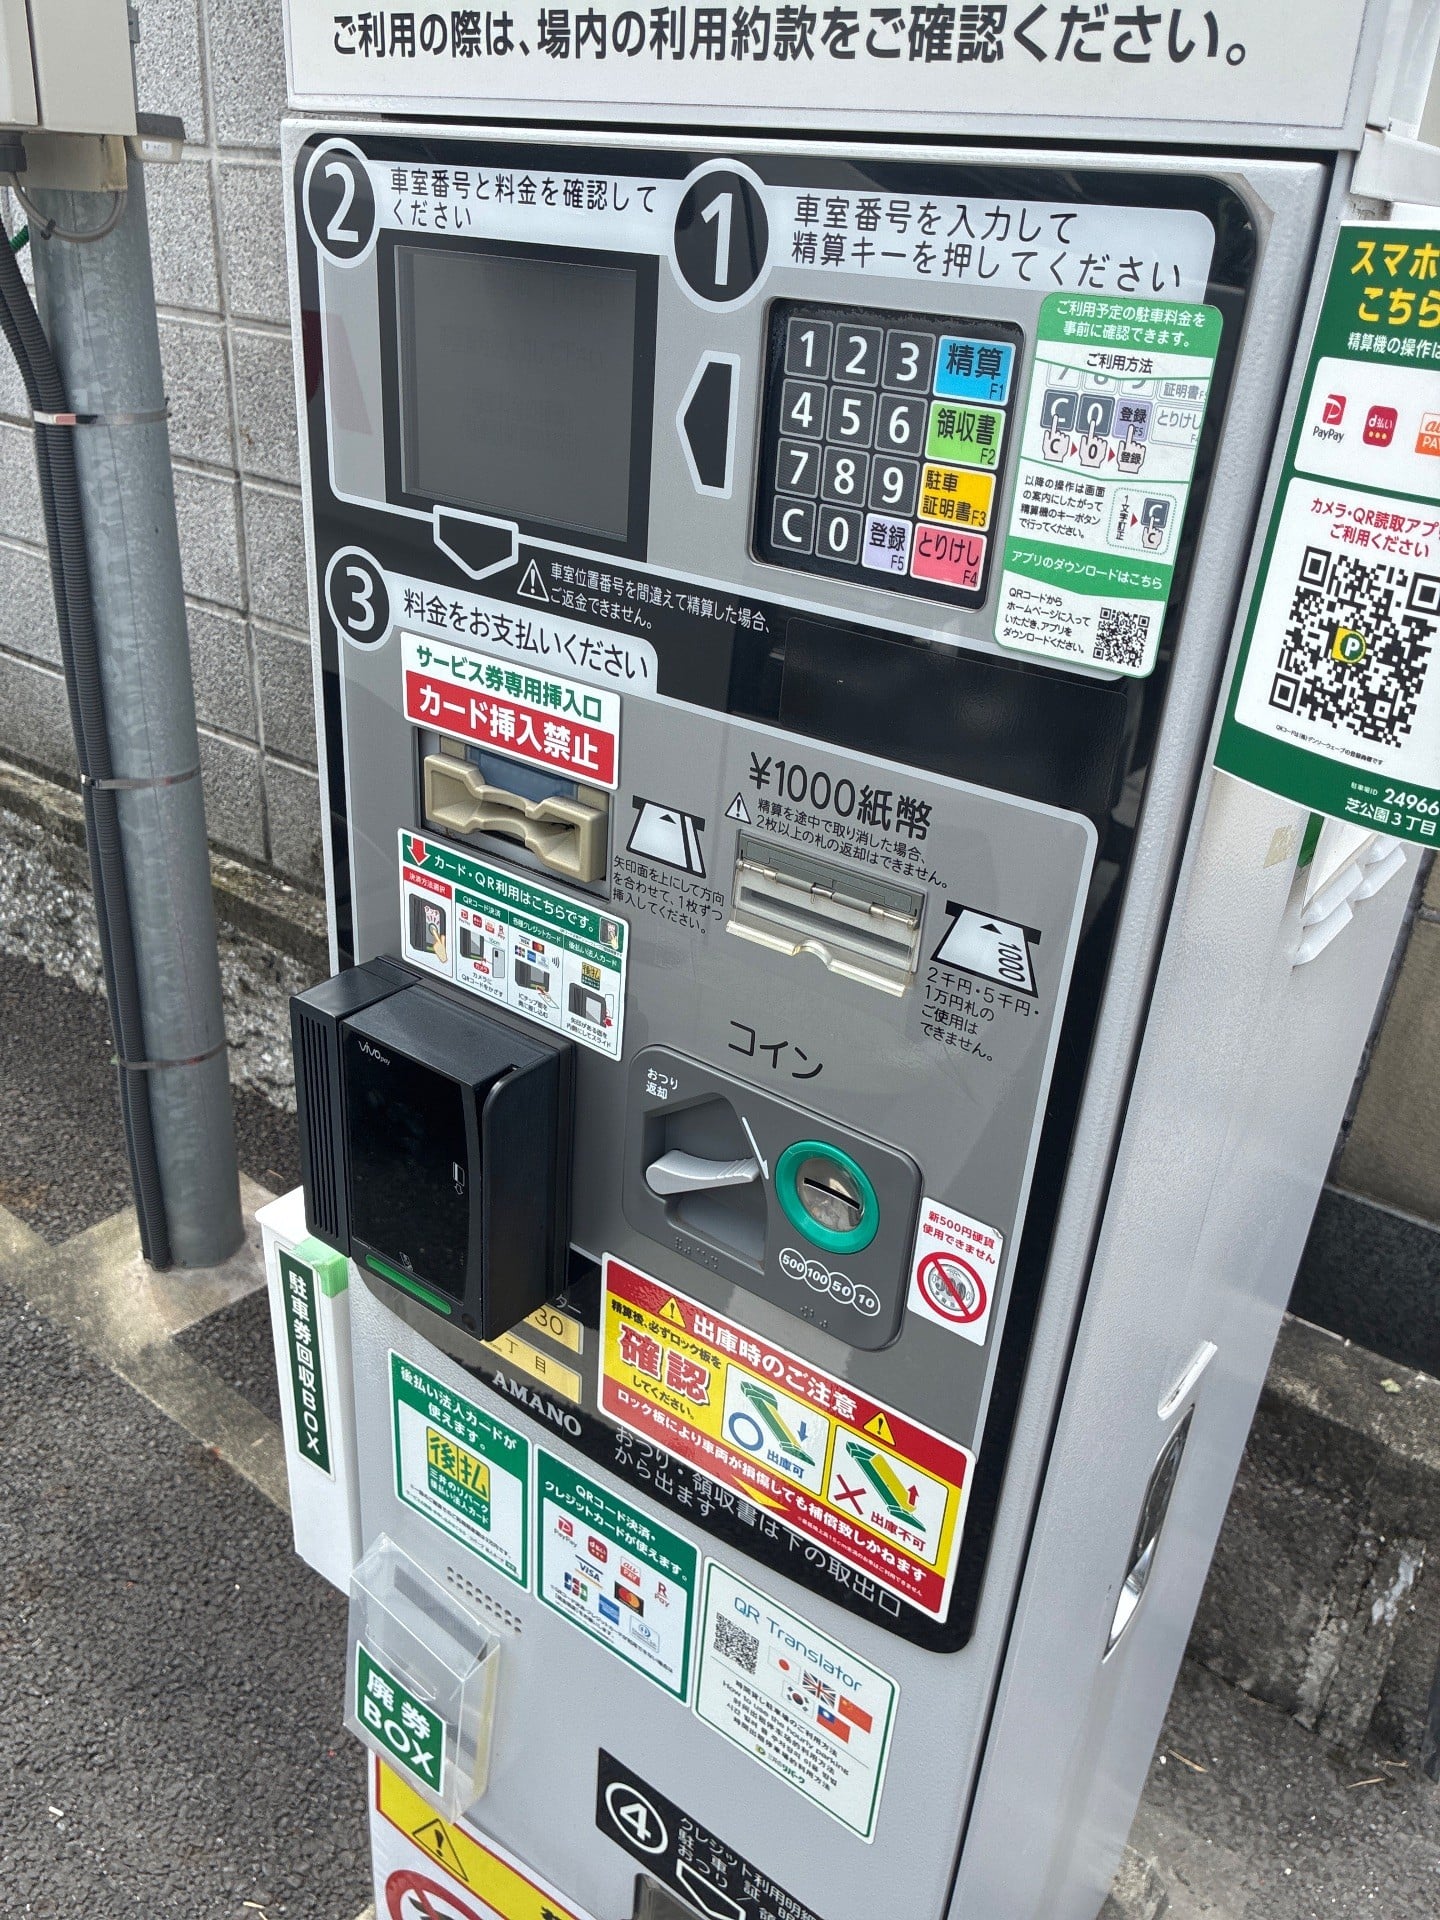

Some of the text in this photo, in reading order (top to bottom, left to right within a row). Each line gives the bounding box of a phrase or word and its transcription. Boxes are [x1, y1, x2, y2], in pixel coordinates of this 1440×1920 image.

[332, 4, 1246, 66] ご利用の際は、場内の利用約款をご確認ください。
[325, 162, 359, 243] 2
[390, 167, 657, 213] 車室番号と料金を確認して
[391, 201, 472, 229] ください
[794, 195, 1078, 245] 車室番号を入力して
[701, 192, 734, 286] 1
[792, 231, 1181, 293] 精算キーを押してください
[1351, 240, 1440, 281] スマホ
[1056, 299, 1206, 328] ご利用予定の駐車料金を
[1358, 287, 1440, 328] こちら
[800, 330, 814, 367] 1
[1063, 320, 1190, 349] 事前に確認できます。
[845, 336, 868, 375] 2
[896, 342, 920, 381] 3
[945, 343, 1004, 378] 精算
[1086, 353, 1153, 374] ご利用方法
[990, 383, 1005, 400] F1
[1163, 382, 1199, 399] 証明書
[791, 392, 813, 428] 4
[840, 398, 862, 435] 5
[889, 406, 910, 444] 6
[937, 407, 997, 445] 領収書
[1120, 406, 1147, 424] 登録
[1158, 411, 1201, 430] とりけし
[1368, 414, 1393, 430] d払い
[1050, 439, 1142, 465] C 0 登録
[1312, 425, 1345, 443] PayPay
[790, 450, 809, 485] 7
[980, 448, 996, 466] F2
[834, 459, 856, 495] 8
[882, 467, 904, 503] 9
[925, 470, 958, 493] 駐車
[1024, 475, 1106, 498] 以降の操作は画面
[922, 495, 987, 527] 証明書 F3
[1020, 503, 1101, 525] 精算機のキーボタン
[1022, 490, 1103, 511] の案内にしたがって
[1116, 495, 1130, 540] 1文字訂正
[1311, 498, 1440, 541] カメラ・QR読取アプ
[782, 509, 805, 543] C
[829, 517, 849, 551] 0
[869, 522, 906, 552] 登録
[1019, 517, 1086, 539] で行ってください。
[1148, 533, 1156, 544] C
[1330, 523, 1430, 558] ご利用ください
[891, 555, 905, 571] F5
[918, 531, 980, 566] とりけし
[963, 569, 978, 587] F4
[1011, 550, 1163, 590] アプリのダウンロードはこちら
[345, 566, 375, 632] 3
[549, 562, 771, 634] 車室位置番号を間違えて精算した場合、
[549, 588, 654, 630] ご返金できません。
[1006, 600, 1091, 626] ホームページに入って
[1008, 587, 1063, 607] QRコードから
[403, 588, 648, 680] 料金をお支払いください
[1003, 627, 1085, 653] ダウンロードください。
[1005, 613, 1073, 637] いただき、アプリを
[416, 645, 602, 723] サービス券専用挿入口
[418, 684, 600, 772] カード挿入禁止
[749, 752, 933, 840] ¥1000紙幣
[1351, 781, 1440, 816] 駐車場ID 24966
[757, 797, 927, 864] 精算を途中で取り消した場合、
[755, 814, 949, 889] 2枚以上の札の返却はできません。
[409, 871, 446, 895] 決済方法選択
[434, 854, 594, 933] カード・QR利用はこちらです。
[613, 871, 723, 921] を合わせて、1枚ずつ
[614, 855, 725, 908] 矢印面を上にして方向
[463, 896, 501, 918] QRコード決済
[613, 887, 706, 934] 挿入してください。
[512, 917, 561, 942] 各種クレジットカード
[568, 940, 617, 967] 後払い法人カード
[997, 942, 1027, 983] 1000
[461, 974, 503, 997] QRコードをかざす
[473, 972, 493, 985] カメラに
[922, 1004, 978, 1036] ご使用は
[925, 985, 995, 1022] 1万円札の
[566, 1022, 611, 1048] 内側にしてスライド
[728, 1020, 824, 1079] コイン
[920, 1021, 994, 1062] できません。
[645, 1081, 668, 1100] 返却
[646, 1068, 679, 1090] おつり
[923, 1223, 996, 1264] 使用できません
[929, 1210, 995, 1249] 新500円硬貨
[782, 1253, 875, 1309] 500 100 50 10
[611, 1299, 721, 1370] 精算後、必ずロック板を
[288, 1270, 321, 1456] 駐車券回収BOX
[618, 1324, 711, 1407] 確認
[694, 1313, 856, 1420] 出庫時のご注意
[400, 1366, 517, 1450] 後払い法人カードが
[492, 1370, 582, 1436] AMANO
[633, 1375, 695, 1420] してください。
[428, 1402, 486, 1450] 使えます。
[429, 1435, 488, 1498] 後払
[614, 1446, 715, 1518] から出ます
[767, 1449, 804, 1480] 出庫可
[430, 1468, 489, 1514] 三井のリパーク
[430, 1479, 489, 1524] 後払い法人カード
[617, 1389, 927, 1582] ロック板により車両が損傷しても補償致しかねます
[545, 1480, 688, 1582] クレジットカードが使えます。
[575, 1484, 656, 1541] QRコード決済・
[616, 1426, 900, 1617] おつり・領収書は下の取出口
[871, 1511, 926, 1552] 出庫不可
[554, 1528, 578, 1549] PayPay
[579, 1562, 602, 1583] VISA
[622, 1560, 640, 1575] au
[654, 1593, 670, 1608] Pay
[658, 1582, 668, 1597] R
[734, 1596, 862, 1692] QR Translator
[367, 1669, 431, 1740] 廃券
[364, 1694, 434, 1779] BOX
[723, 1680, 741, 1697] How
[743, 1695, 752, 1705] to
[753, 1703, 769, 1717] use
[771, 1715, 784, 1729] the
[786, 1726, 814, 1750] hourly
[816, 1748, 849, 1776] parking
[620, 1802, 651, 1841] 4
